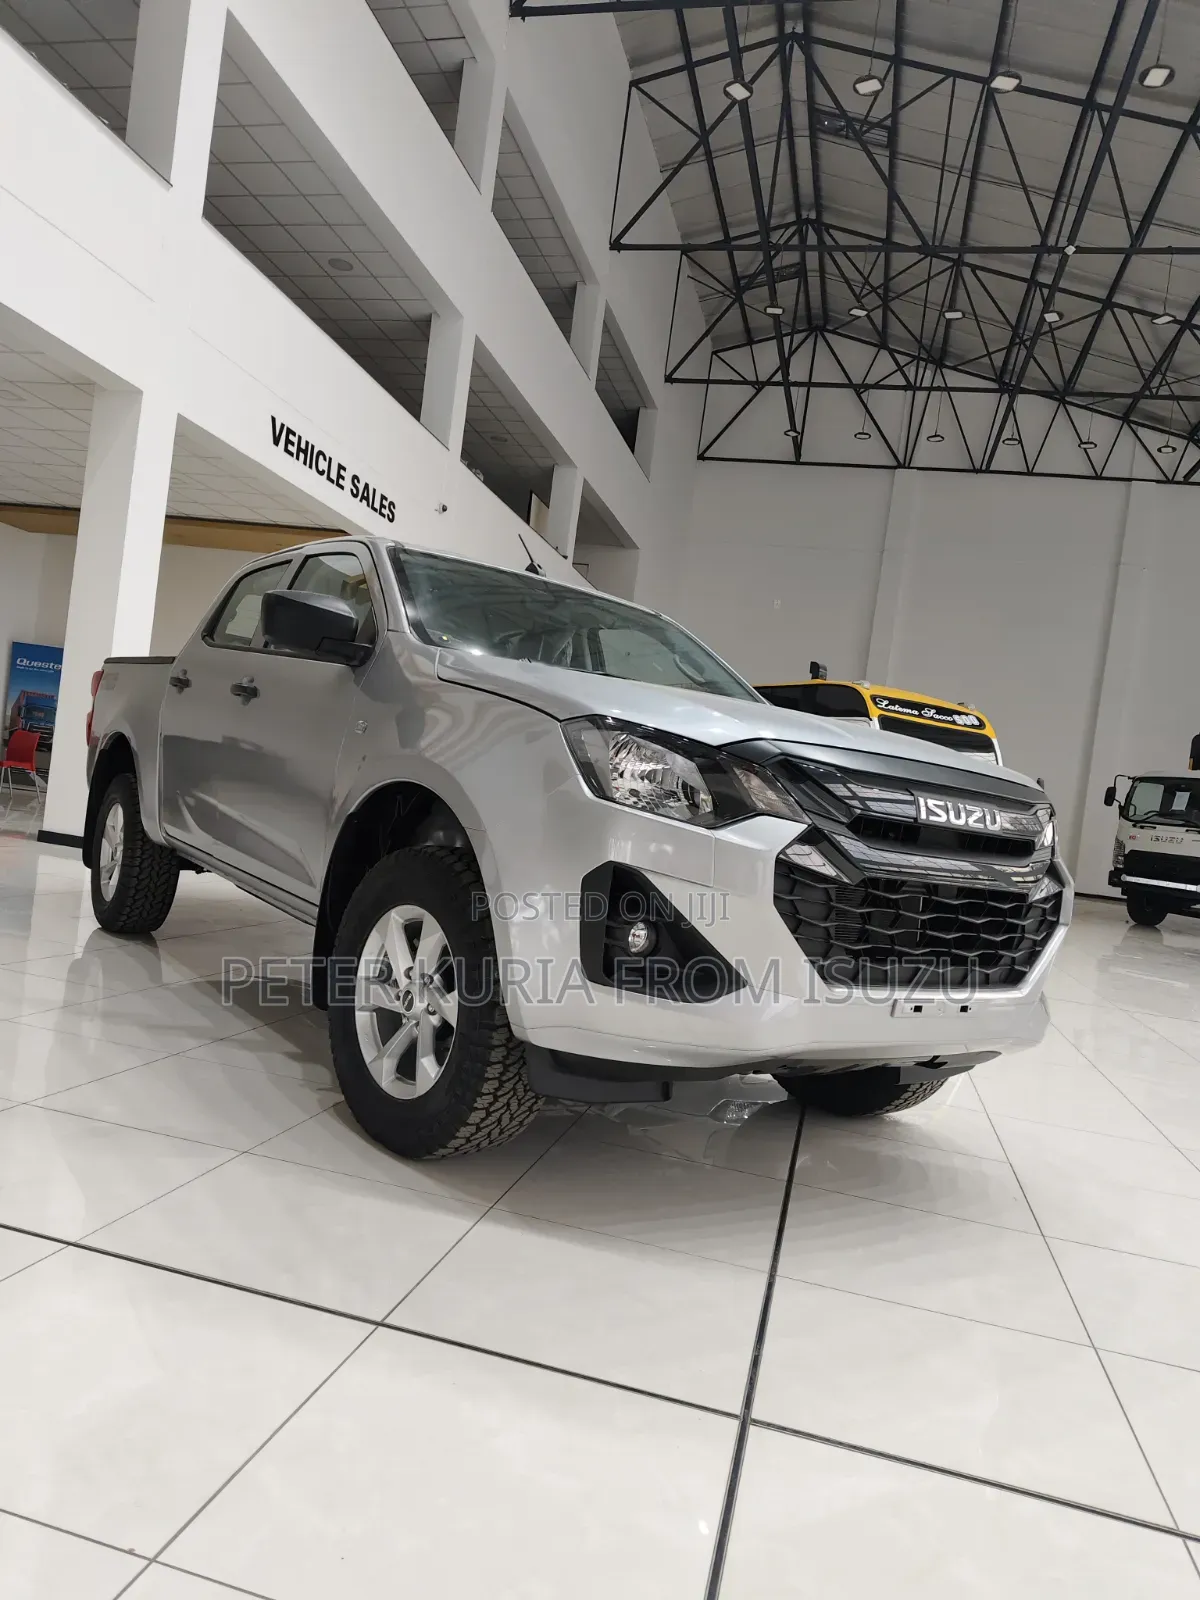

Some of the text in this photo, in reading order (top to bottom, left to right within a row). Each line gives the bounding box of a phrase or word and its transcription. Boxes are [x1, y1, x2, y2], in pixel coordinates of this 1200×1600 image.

[271, 415, 396, 523] VEHICLE SALES
[876, 698, 919, 716] Latema
[921, 707, 954, 721] Sacco
[918, 796, 1001, 831] ISUZU
[1150, 834, 1184, 844] ISUZU
